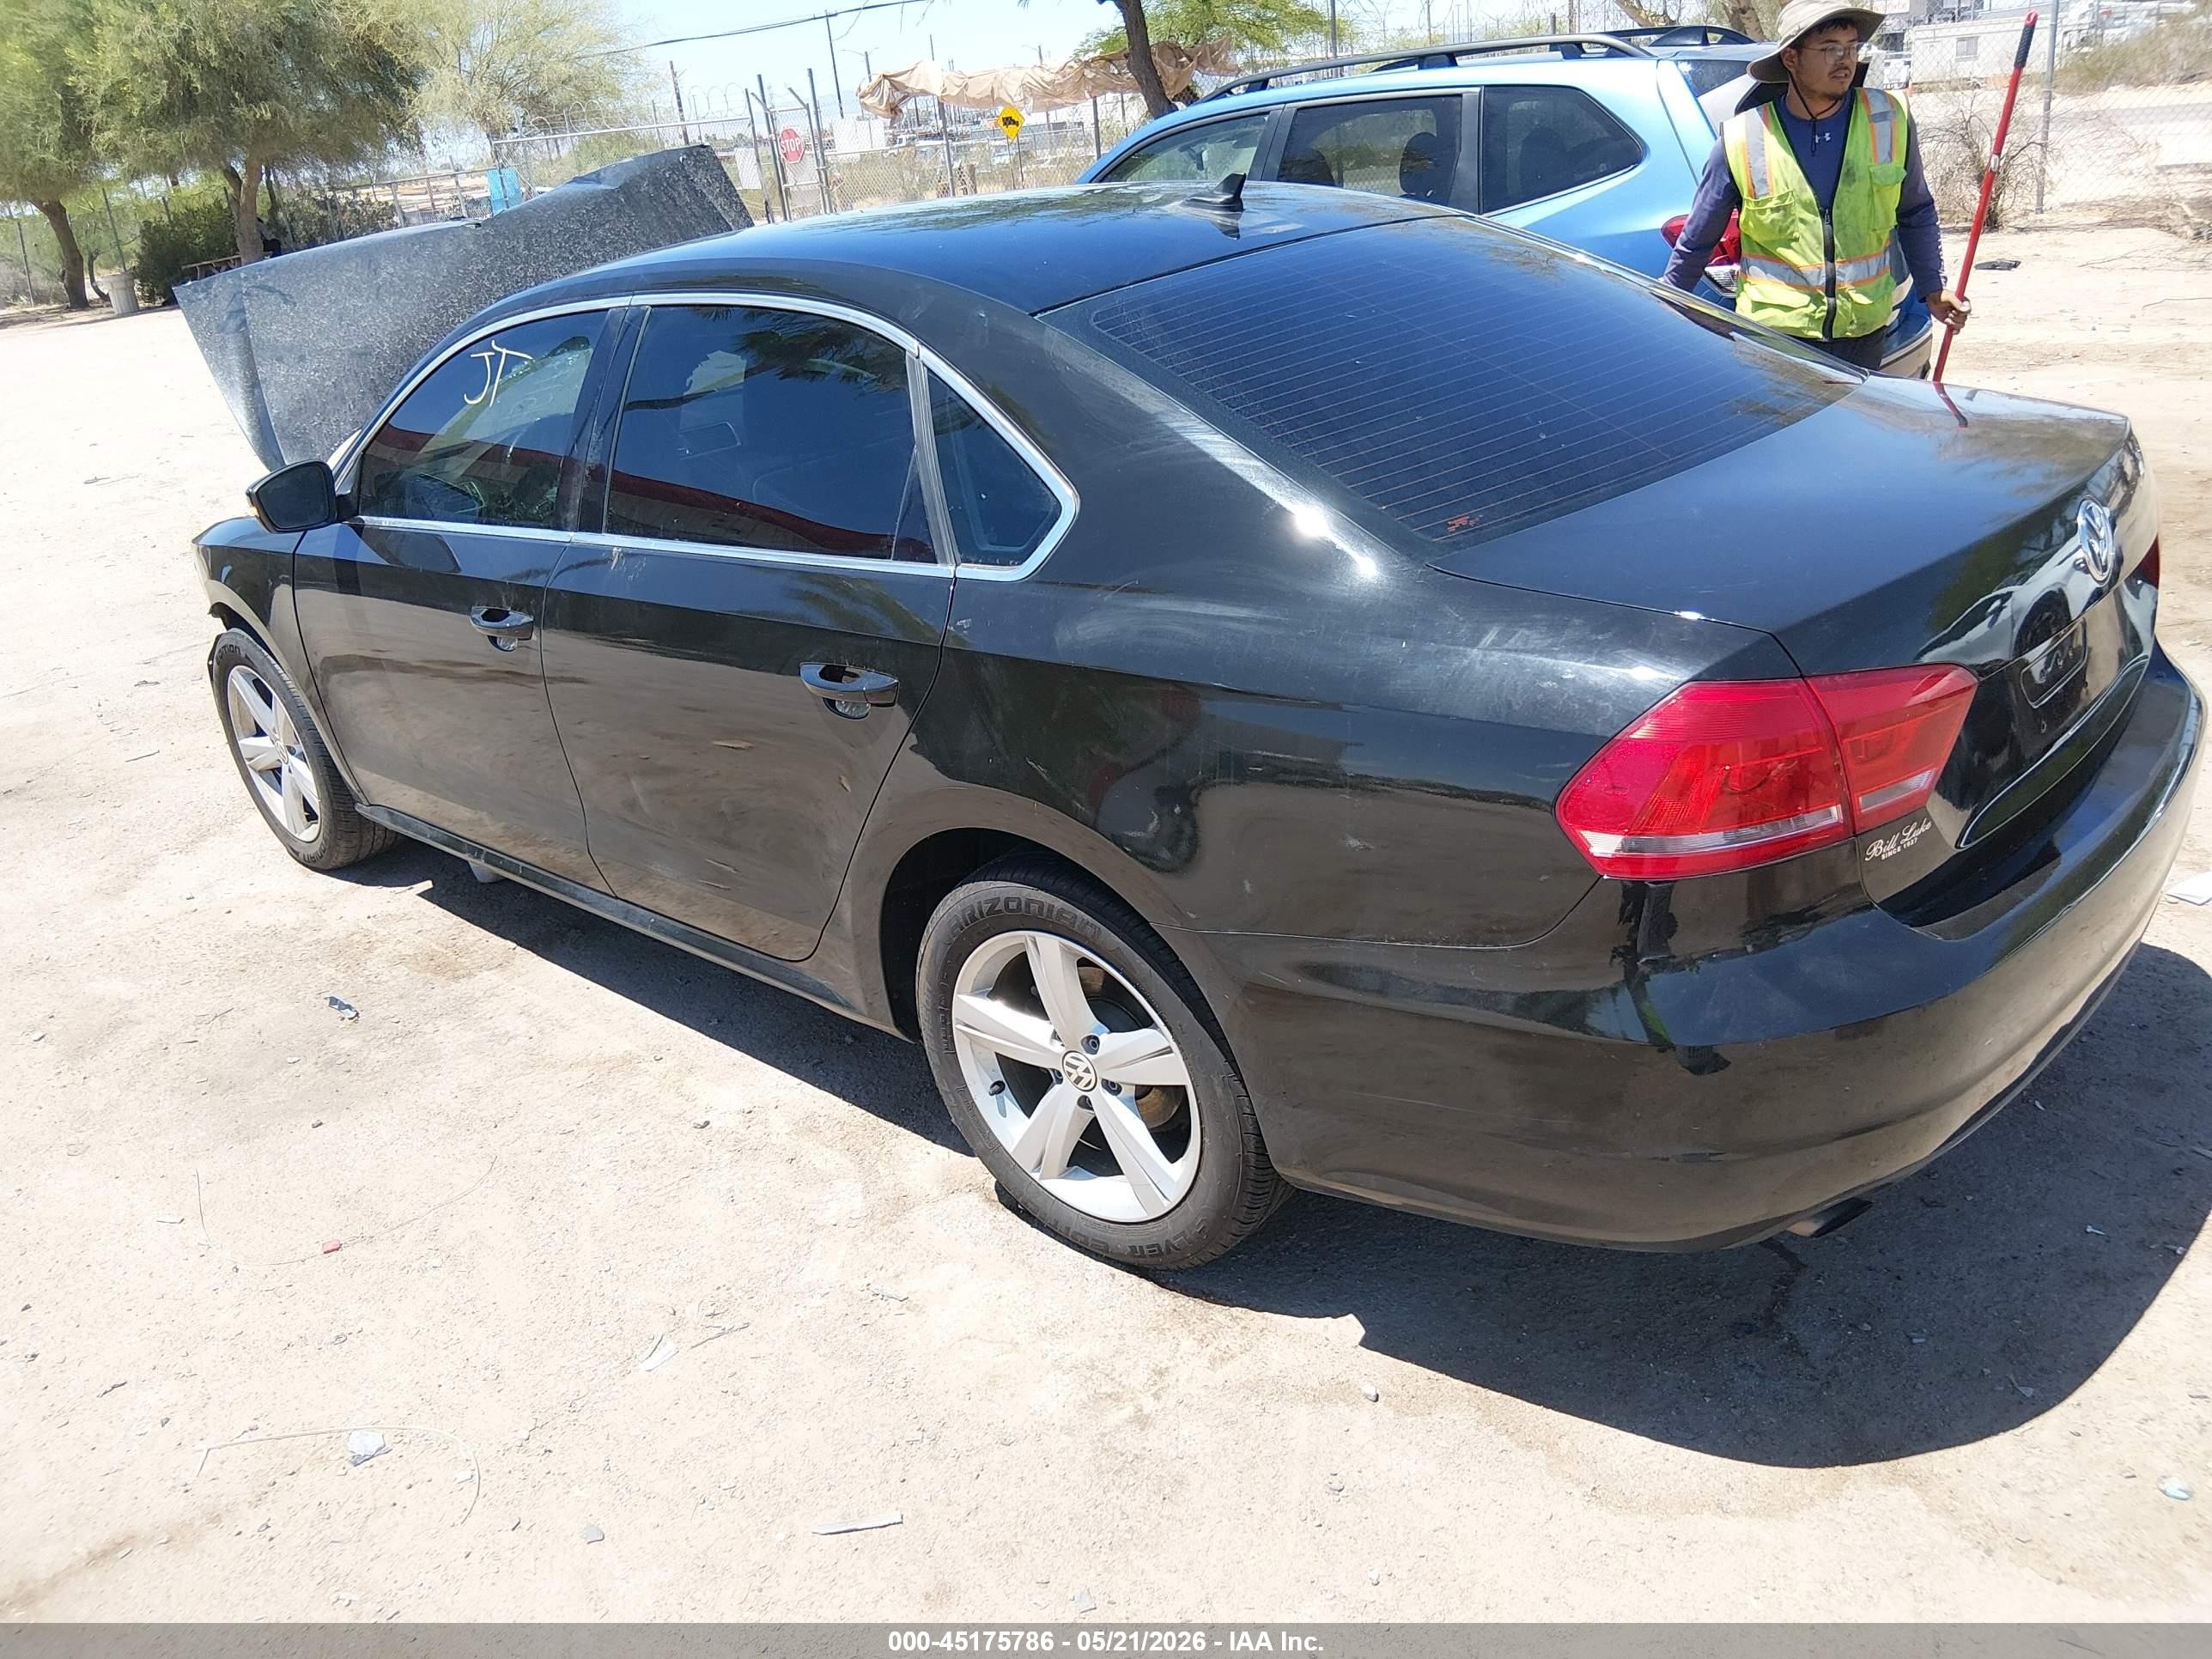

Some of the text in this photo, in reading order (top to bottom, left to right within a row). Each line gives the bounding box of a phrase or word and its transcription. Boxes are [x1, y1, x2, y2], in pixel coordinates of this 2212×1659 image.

[781, 137, 800, 154] STOP
[464, 339, 535, 408] JT
[1864, 817, 1932, 861] Bill Luke
[1881, 847, 1901, 860] SINCE
